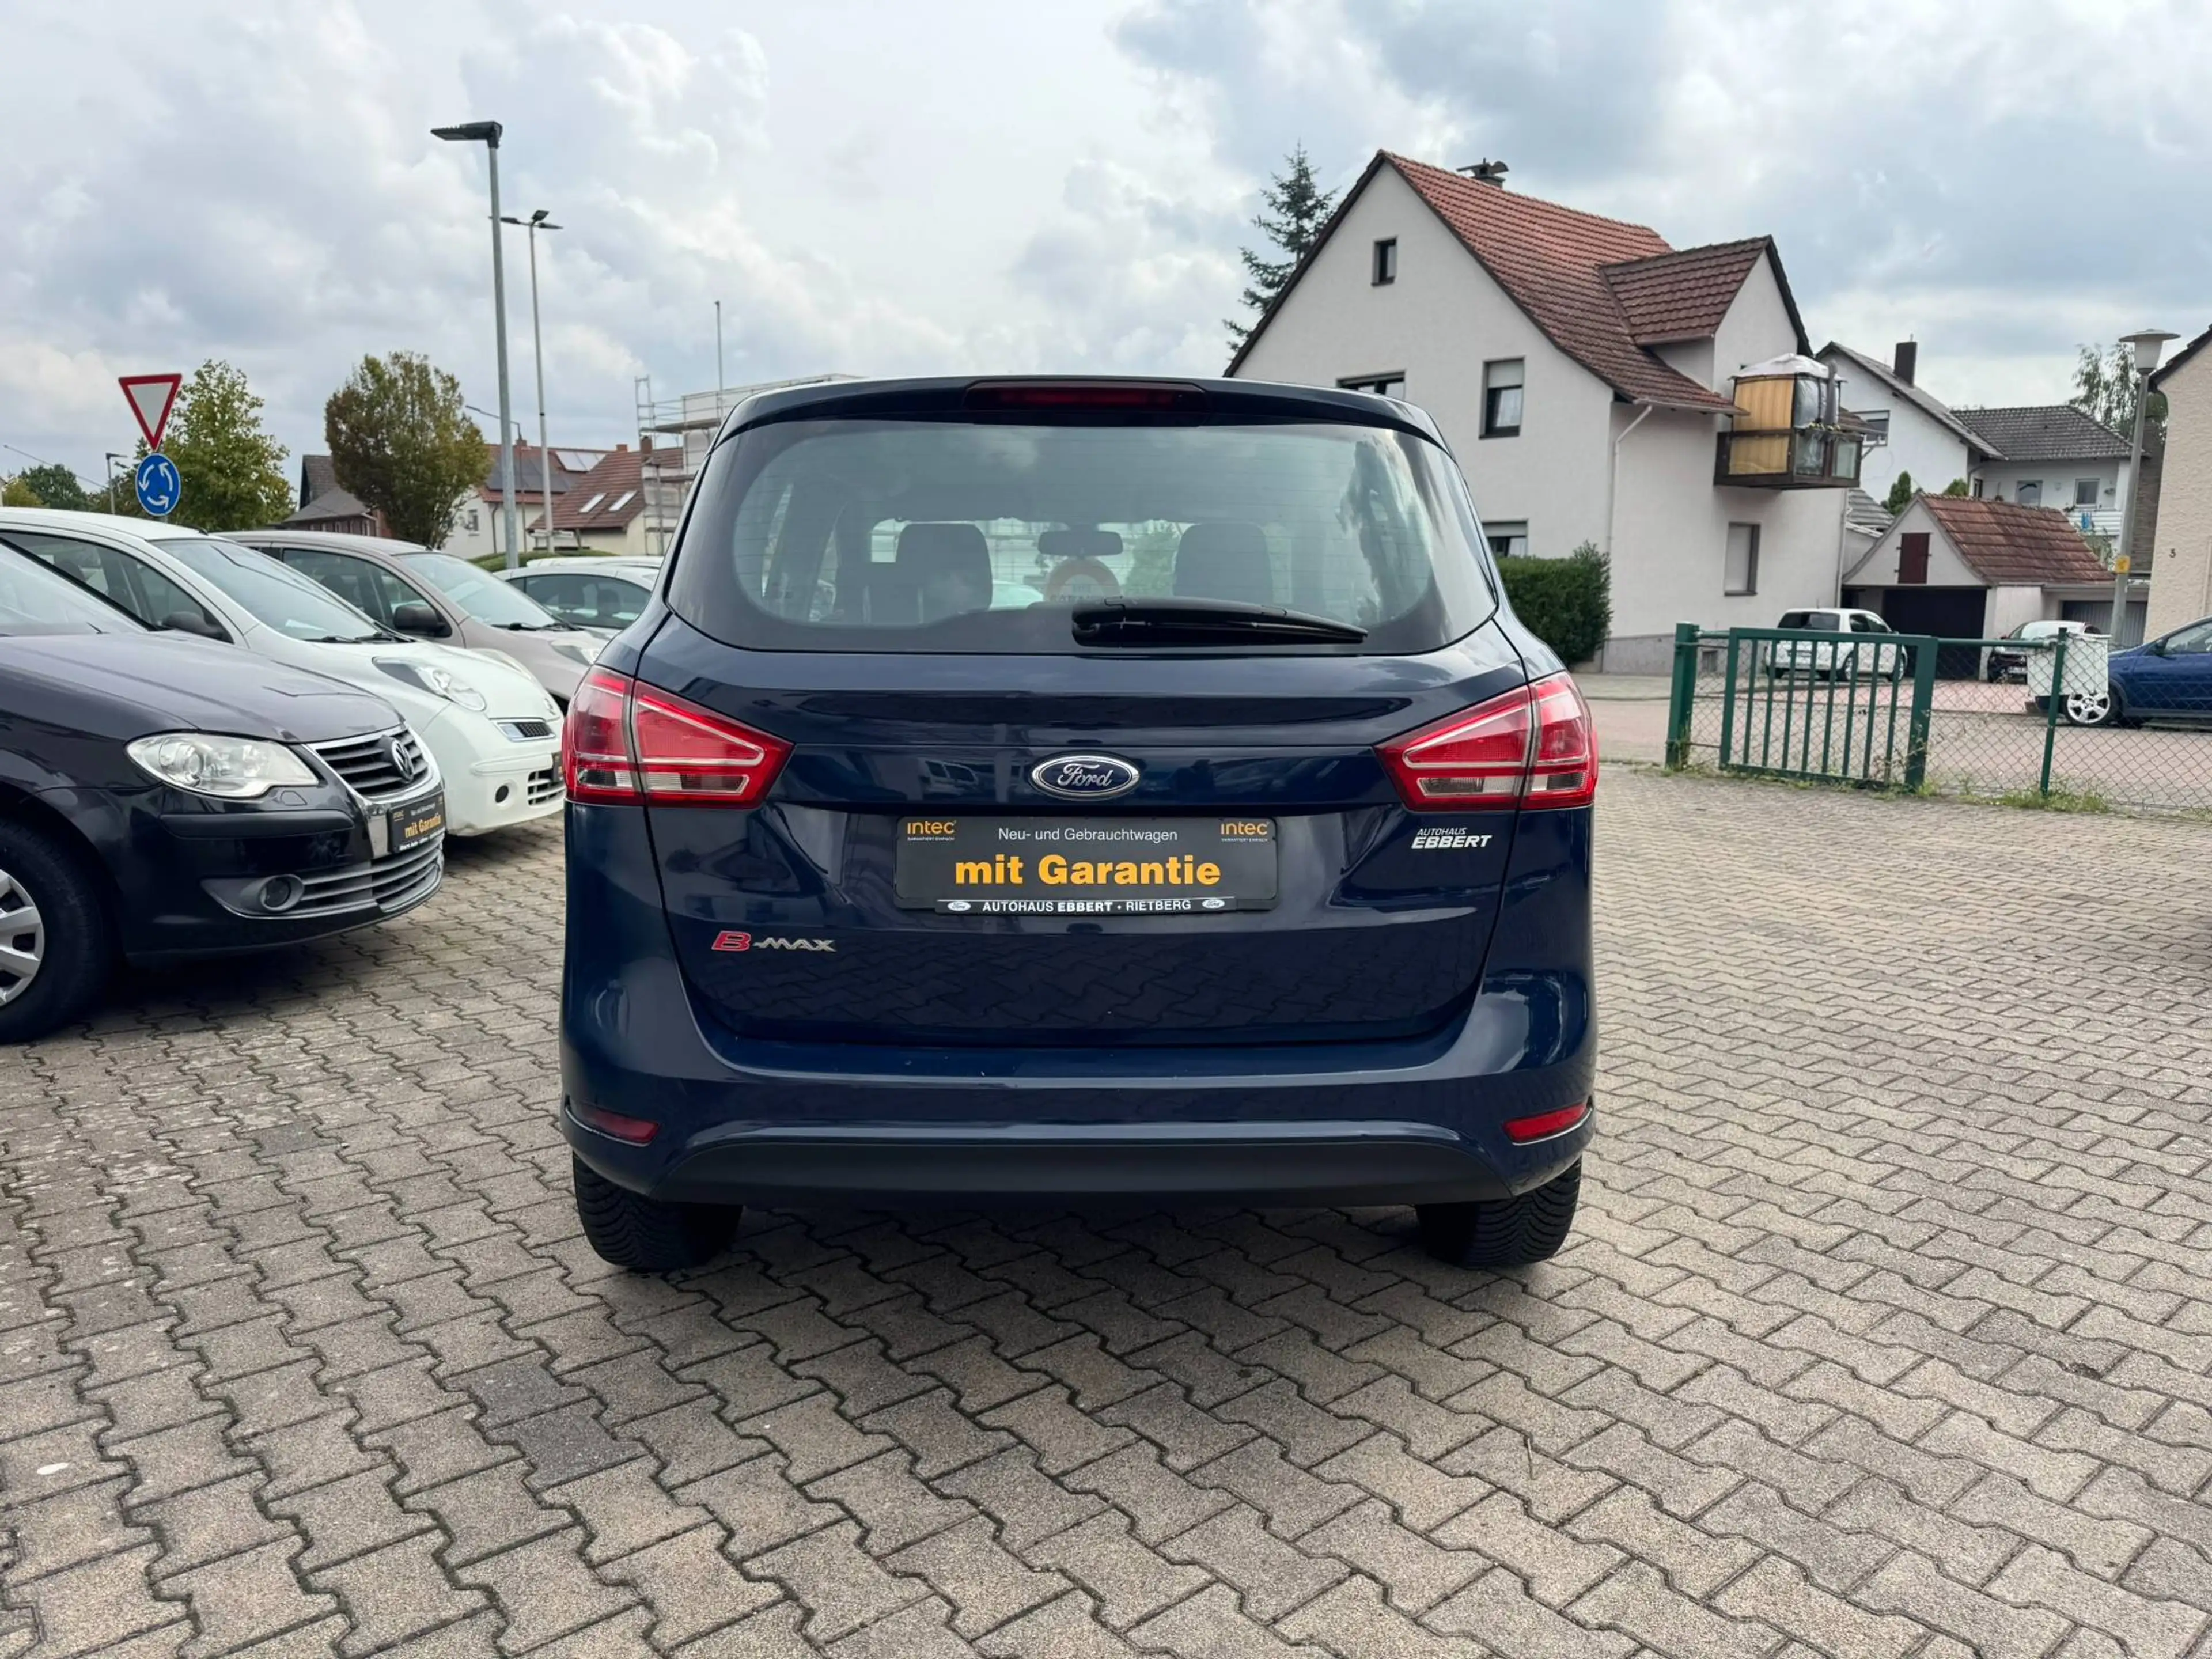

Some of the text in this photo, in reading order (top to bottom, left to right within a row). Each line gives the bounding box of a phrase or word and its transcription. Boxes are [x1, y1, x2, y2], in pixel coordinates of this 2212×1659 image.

[1057, 763, 1114, 786] Ford
[907, 820, 955, 835] intec
[1221, 821, 1268, 835] intec
[1417, 827, 1467, 836] AUTOHAUS
[998, 828, 1178, 843] Neu- und Gebrauchtwagen
[1411, 835, 1493, 849] EBBERT
[955, 854, 1222, 885] mit Garantie
[982, 902, 1054, 912] AUTOHAUS
[1057, 902, 1113, 912] EBBERT
[1126, 900, 1191, 911] RIETBERG
